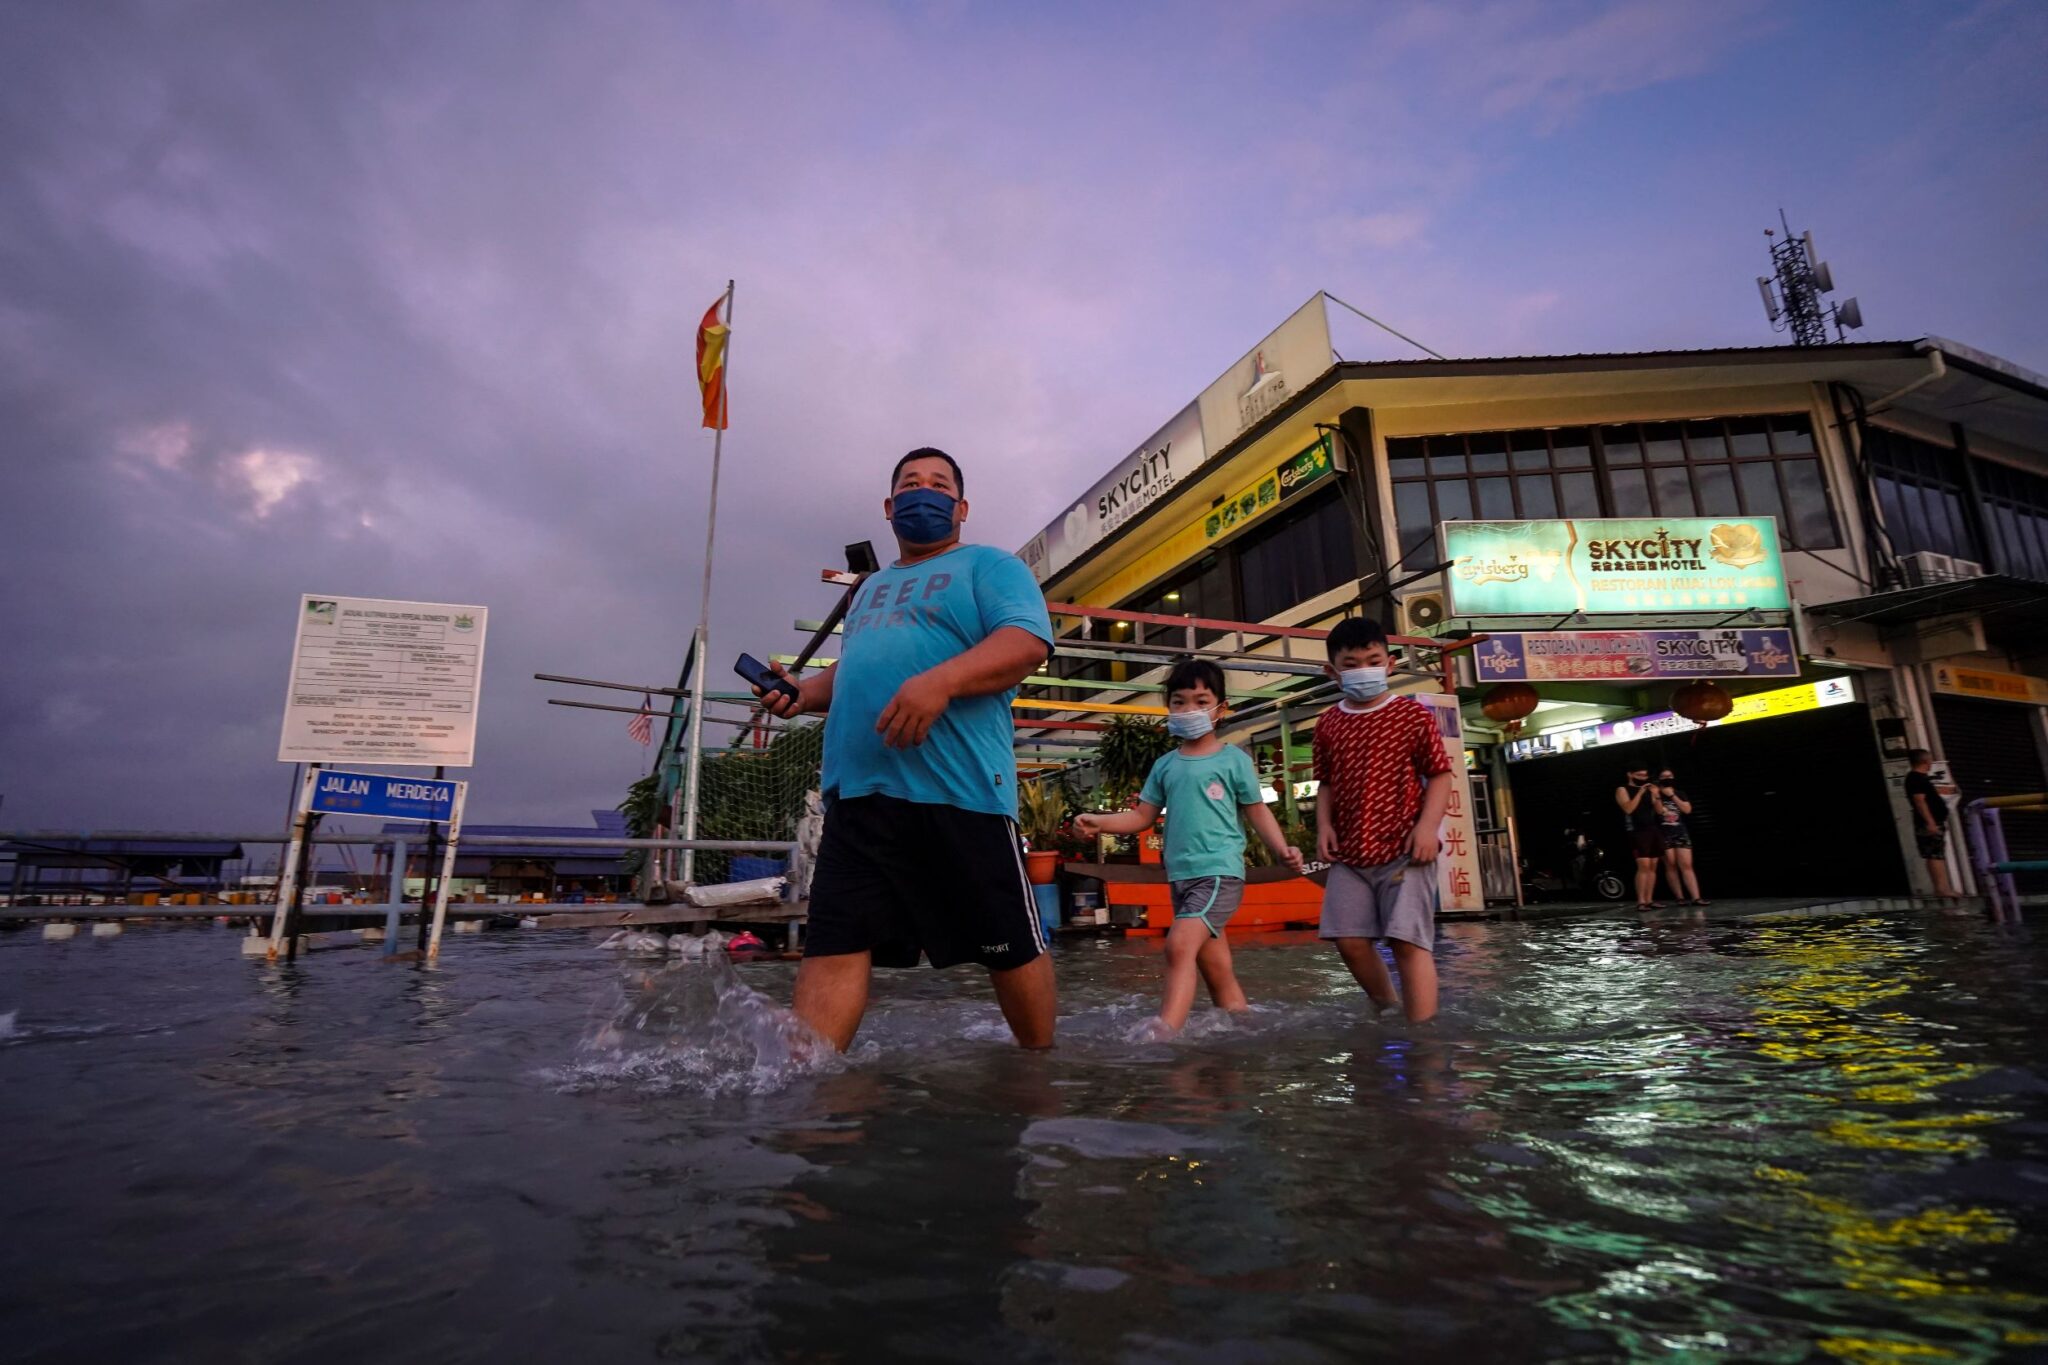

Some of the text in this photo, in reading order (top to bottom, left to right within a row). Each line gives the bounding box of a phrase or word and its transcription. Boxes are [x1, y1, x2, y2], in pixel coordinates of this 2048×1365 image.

[1098, 442, 1172, 520] SKYCITY
[1281, 458, 1314, 487] Carlsberg
[1142, 472, 1176, 504] MOTEL
[1587, 537, 1703, 560] SKYCITY
[1453, 555, 1529, 582] Carlsberg
[1659, 560, 1706, 571] MOTEL
[850, 573, 952, 615] JEEP
[1591, 577, 1667, 592] RESTORAN
[1527, 639, 1578, 656] RESTORAN
[1656, 639, 1738, 656] SKYCITY
[1480, 655, 1520, 673] Tiger
[1750, 652, 1790, 671] Tiger
[320, 776, 449, 802] JALAN MERDEKA
[980, 942, 1010, 953] SPORT
